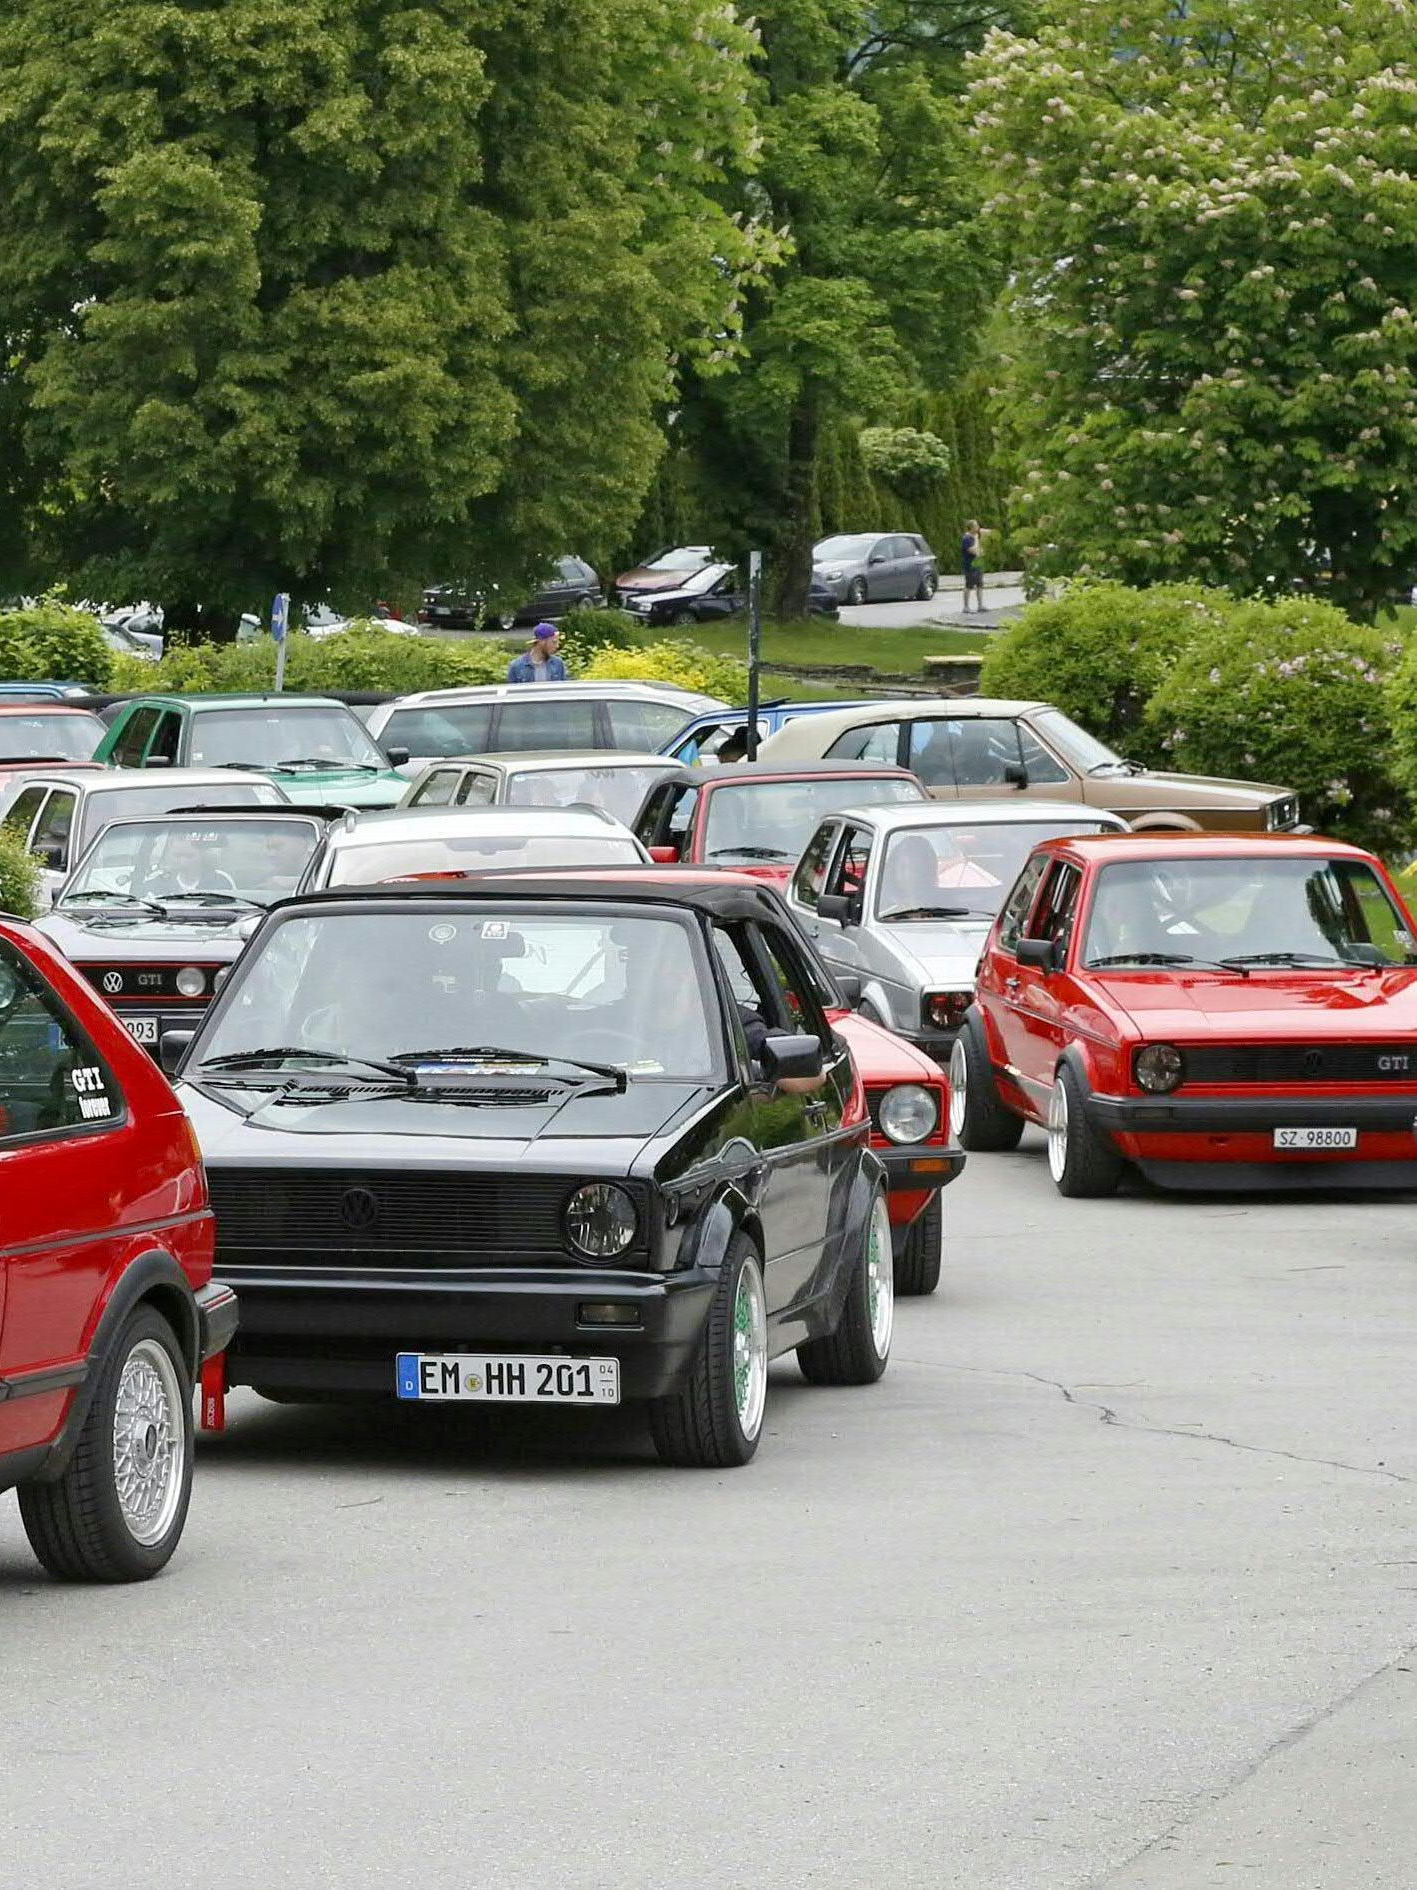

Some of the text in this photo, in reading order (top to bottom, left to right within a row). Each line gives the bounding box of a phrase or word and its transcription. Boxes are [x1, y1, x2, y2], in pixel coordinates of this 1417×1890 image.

[138, 973, 163, 986] GTI
[1378, 1056, 1409, 1070] GTI
[71, 1066, 105, 1093] GTI
[1279, 1131, 1351, 1146] SZ 98800
[599, 1364, 613, 1374] 04
[405, 1380, 414, 1391] D
[420, 1361, 594, 1397] EM HH 201
[601, 1388, 615, 1398] 10
